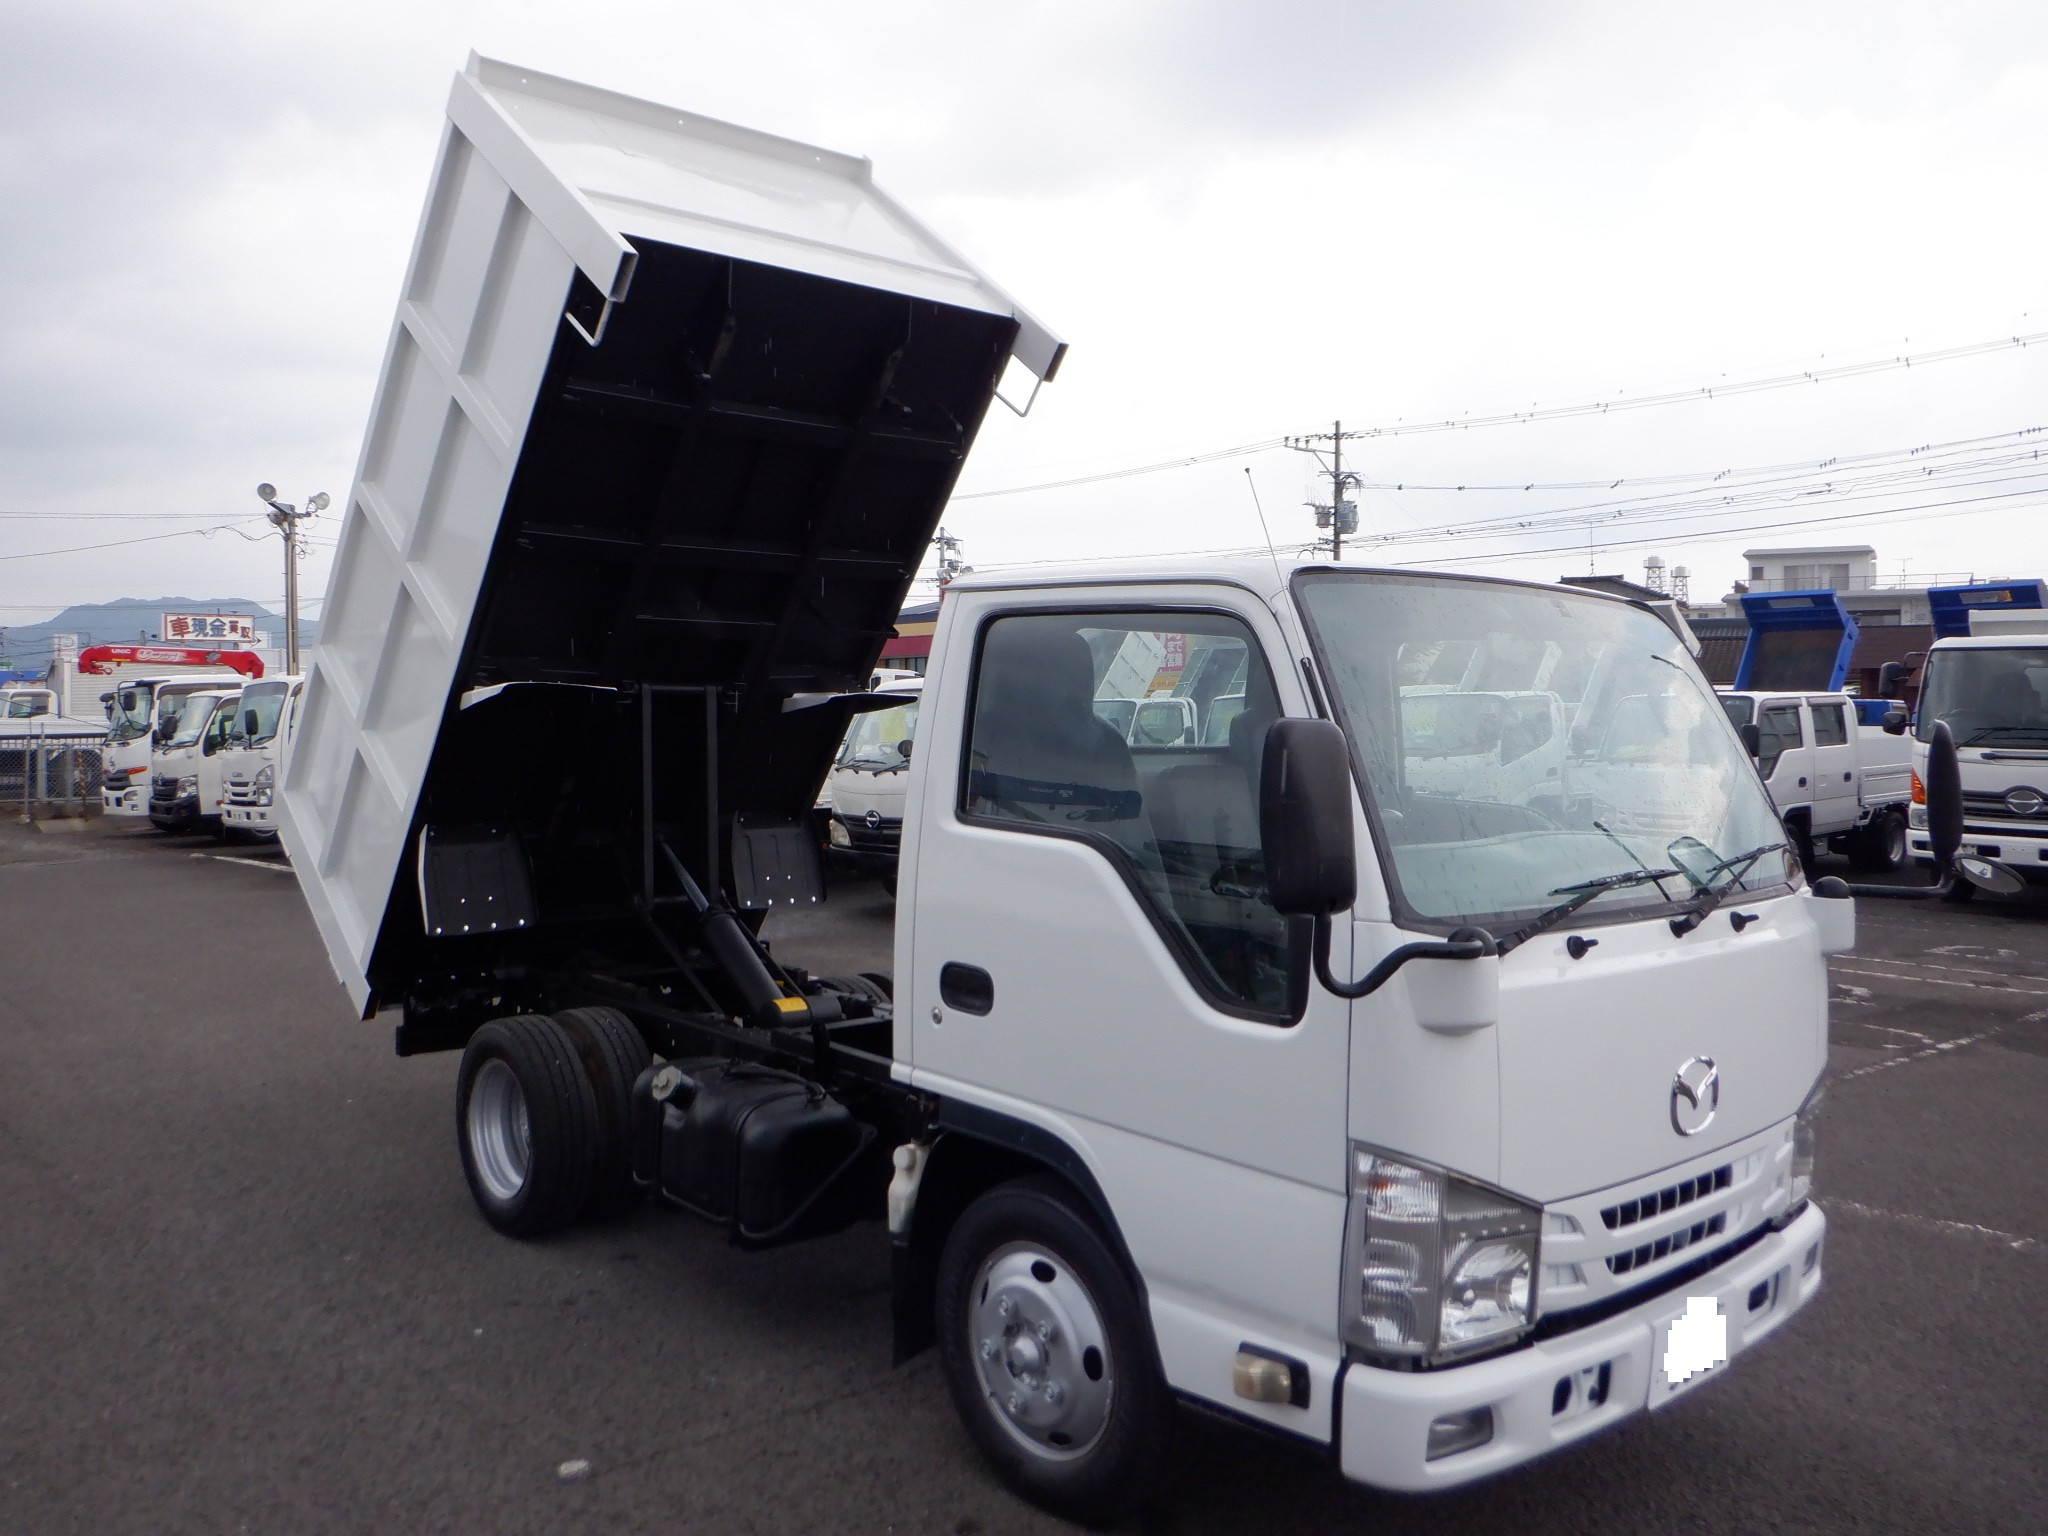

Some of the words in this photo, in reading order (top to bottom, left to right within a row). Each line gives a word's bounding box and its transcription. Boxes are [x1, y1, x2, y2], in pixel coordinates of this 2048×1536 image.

[169, 617, 251, 639] 車現金買取
